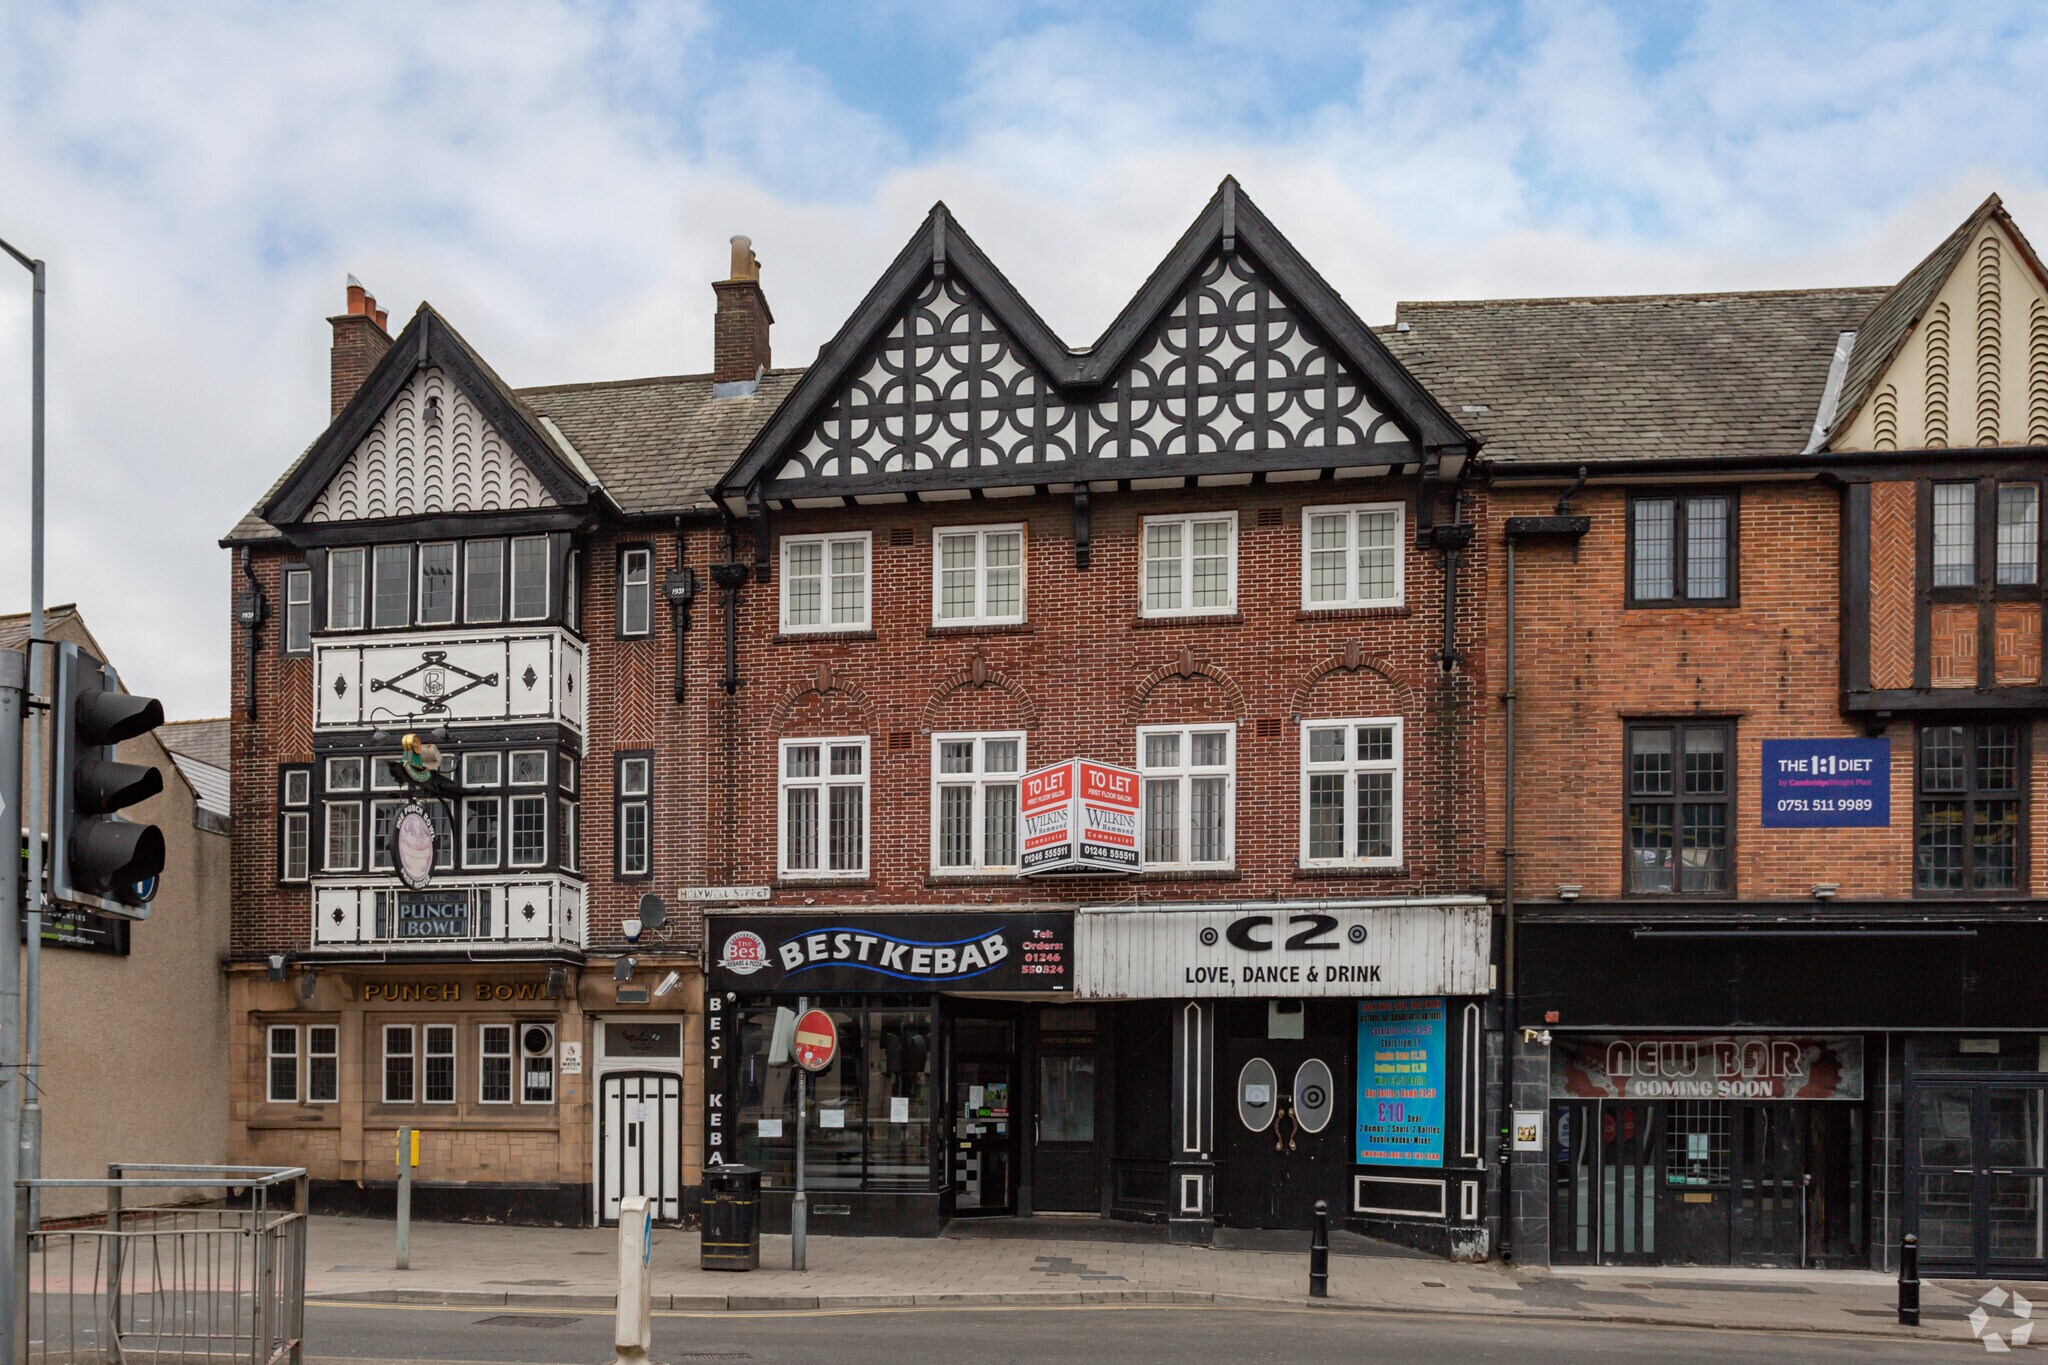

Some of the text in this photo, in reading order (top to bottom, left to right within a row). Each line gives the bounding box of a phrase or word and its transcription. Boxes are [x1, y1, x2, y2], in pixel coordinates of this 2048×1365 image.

[1778, 755, 1873, 775] THE 1:1 DIET
[1028, 772, 1065, 796] TO LET
[1088, 770, 1131, 793] TO LET
[1102, 791, 1116, 799] FLOOR
[1117, 794, 1132, 802] SALON
[1778, 799, 1872, 811] 0751 511 9989
[396, 804, 436, 841] THE PUNCH BOWL
[1025, 809, 1068, 837] WILKINS
[1086, 808, 1135, 829] WILKINS
[1039, 822, 1067, 834] Hammond
[1102, 824, 1134, 835] Hammond
[1027, 832, 1066, 847] Commercial
[1087, 832, 1133, 844] Commercial
[1024, 853, 1043, 864] 01246
[1045, 846, 1068, 858] 555511
[1084, 845, 1135, 861] 01246 555511
[400, 904, 467, 918] PUNCH
[408, 920, 460, 936] BOWL
[1033, 930, 1053, 938] Tel:
[1226, 914, 1340, 951] C2
[728, 945, 760, 958] Best
[779, 934, 1009, 974] BEST KEBAB
[1022, 942, 1063, 950] Orders:
[1025, 953, 1060, 962] 01246
[1022, 965, 1063, 974] 550324
[1186, 965, 1381, 988] LOVE, DANCE & DRINK
[364, 983, 460, 1001] PUNCH
[710, 997, 722, 1069] BEST
[1381, 1039, 1420, 1048] Shots from £1
[1606, 1040, 1804, 1077] NEW BAR
[1396, 1063, 1410, 1073] from
[1365, 1088, 1376, 1098] Any
[1377, 1088, 1394, 1098] Bottle
[1401, 1088, 1417, 1098] Bomb
[1634, 1080, 1773, 1096] COMING SOON
[1378, 1102, 1404, 1122] £10
[1418, 1126, 1440, 1134] Bottles
